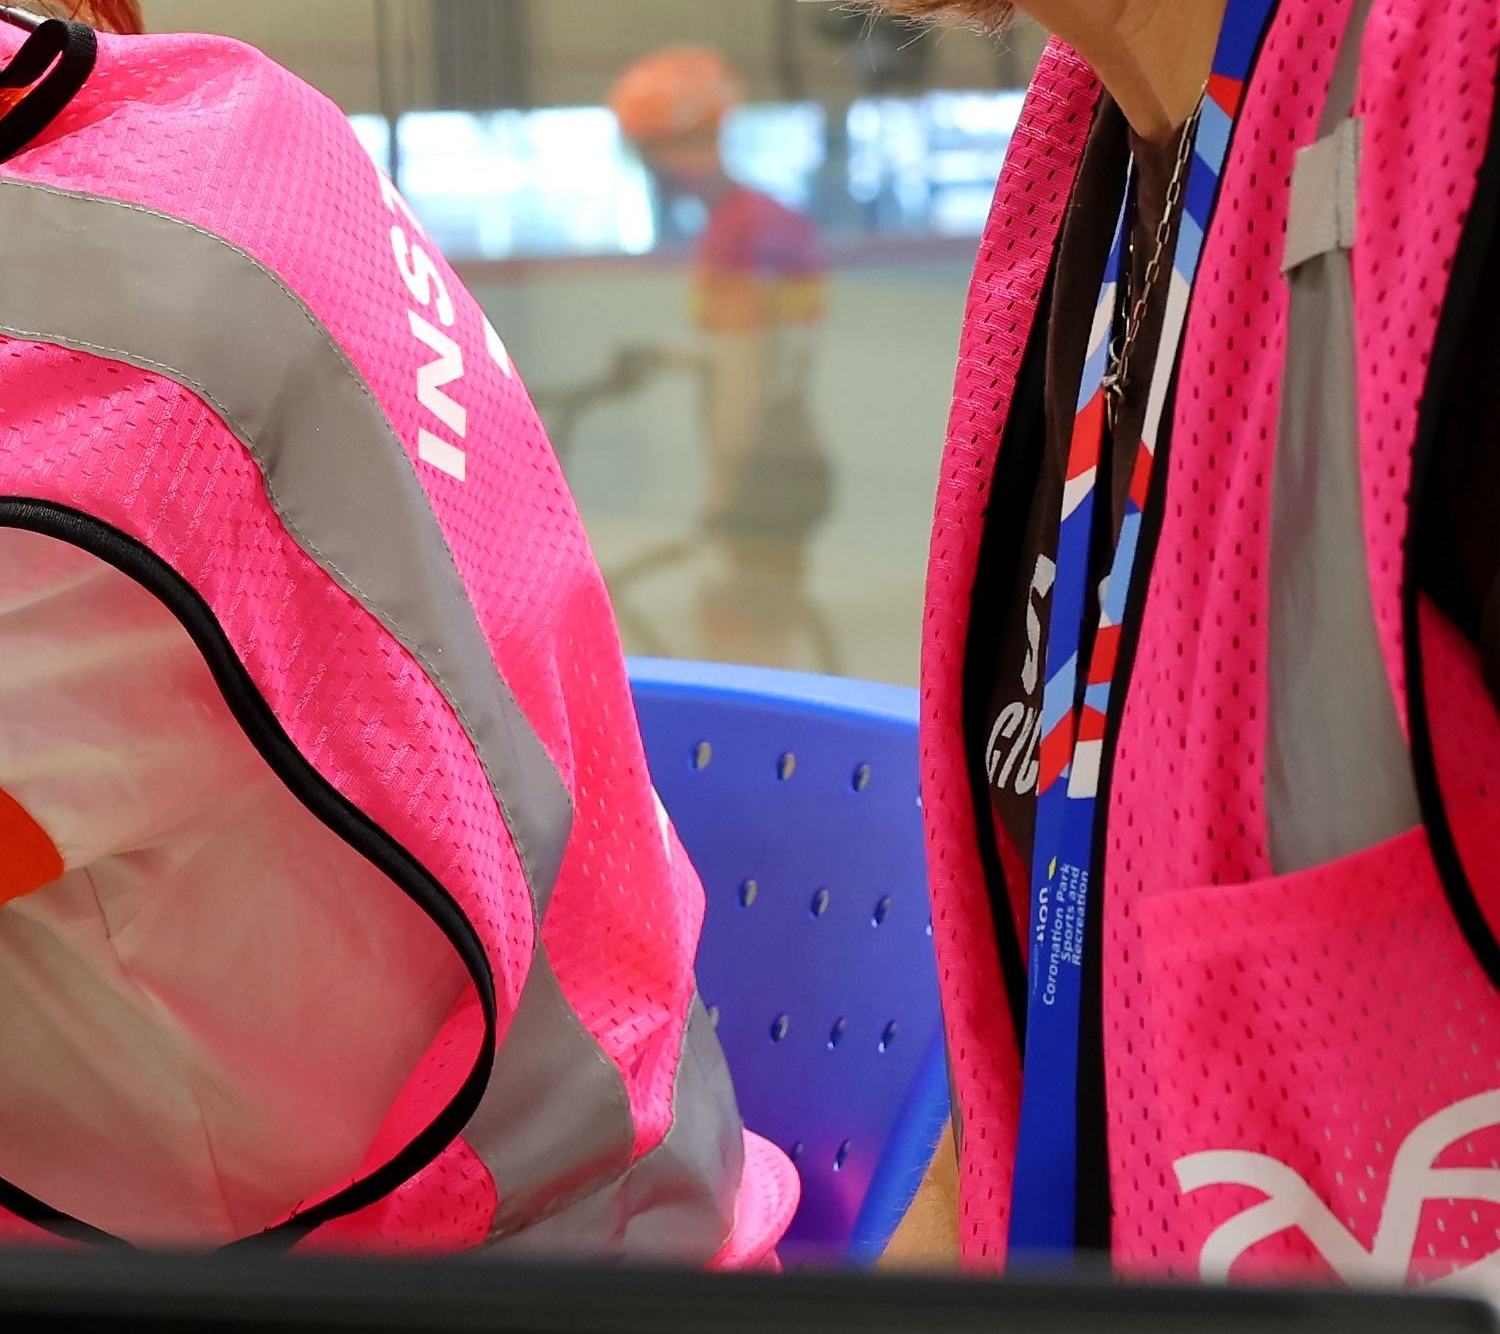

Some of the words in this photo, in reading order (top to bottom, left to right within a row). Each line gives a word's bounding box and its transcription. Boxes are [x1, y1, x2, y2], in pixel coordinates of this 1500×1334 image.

[378, 167, 467, 482] INS
[1043, 907, 1065, 1006] Coronation
[1056, 864, 1071, 904] Park
[1060, 905, 1075, 962] Sports
[1070, 866, 1081, 901] and
[1072, 870, 1089, 966] Recreation
